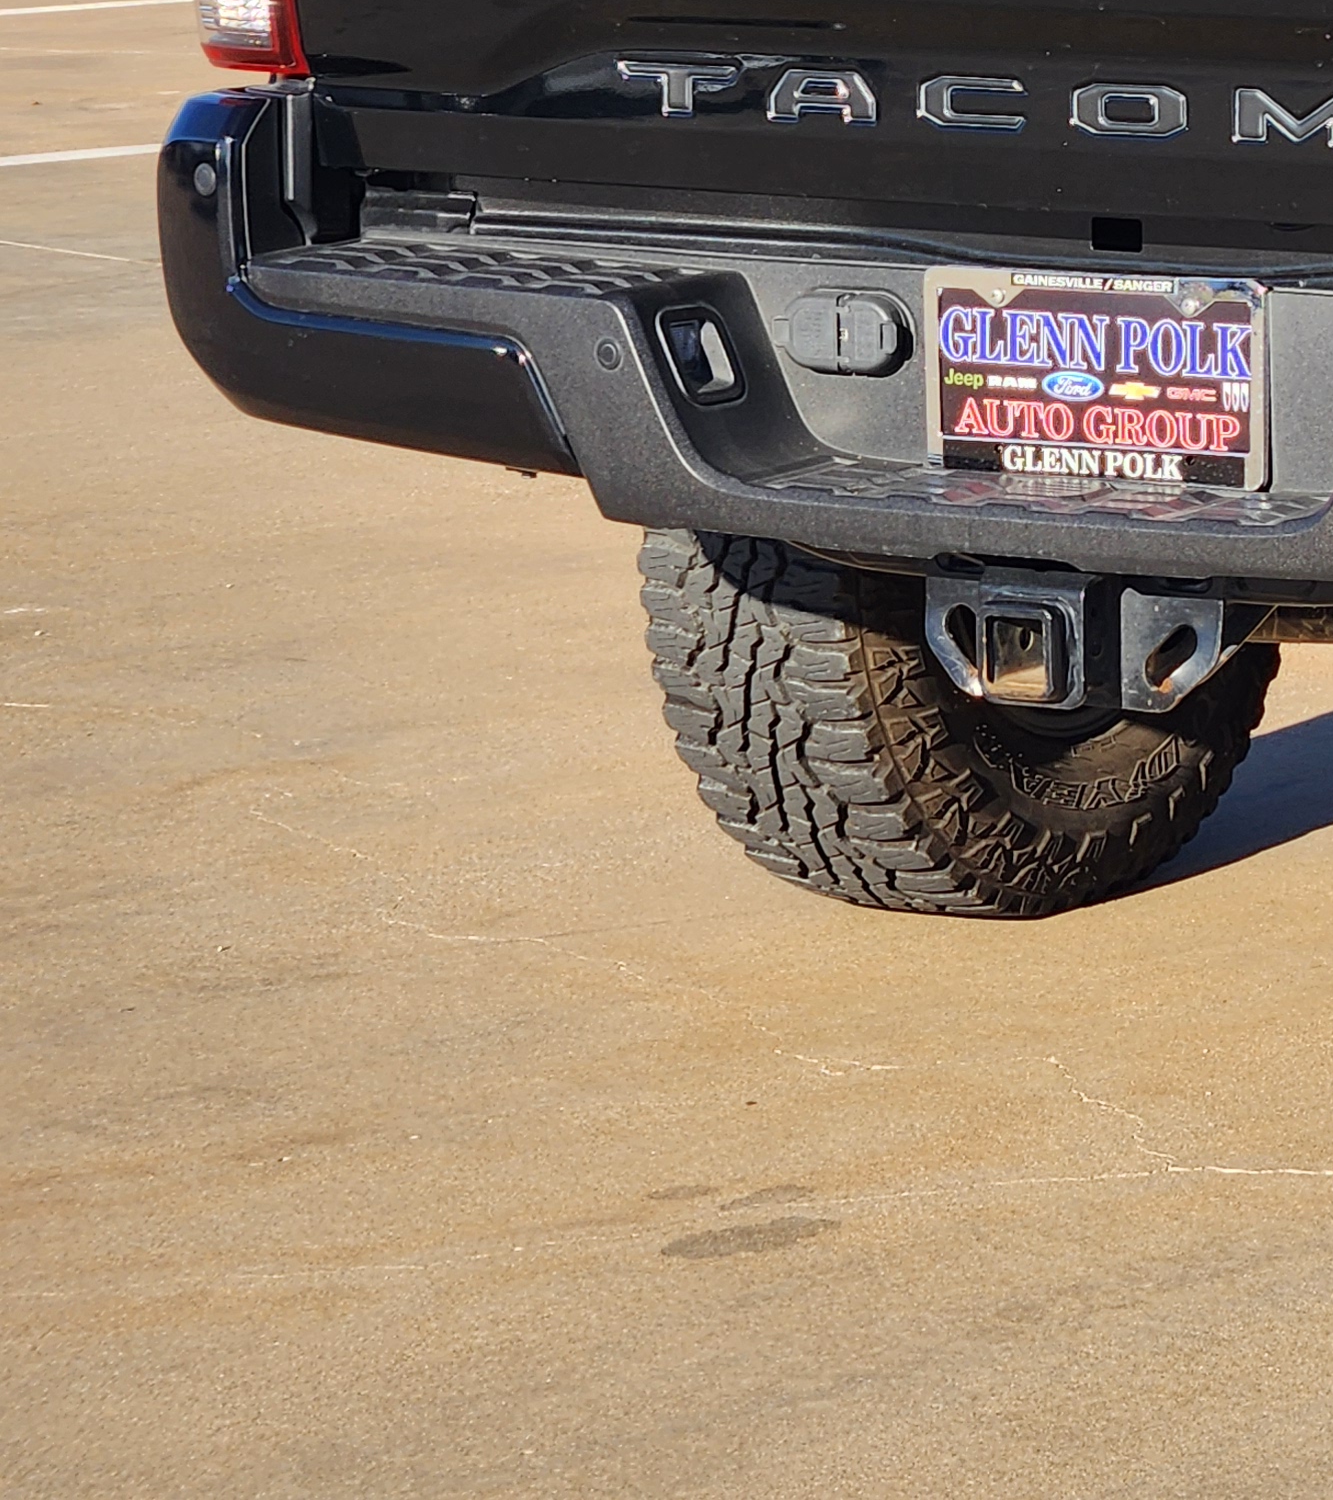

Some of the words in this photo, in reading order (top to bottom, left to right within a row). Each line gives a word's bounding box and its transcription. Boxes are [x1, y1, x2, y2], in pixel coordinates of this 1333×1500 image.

[940, 306, 1109, 372] GLENN
[1116, 317, 1252, 379] POLK
[944, 368, 984, 388] Jeep
[987, 375, 1037, 390] RAM
[1053, 374, 1092, 397] Ford
[1166, 386, 1217, 402] GMC
[955, 397, 1074, 441] AUTO
[1083, 404, 1240, 451] GROUP
[1002, 444, 1100, 477] GLENN
[1104, 452, 1184, 481] POLK
